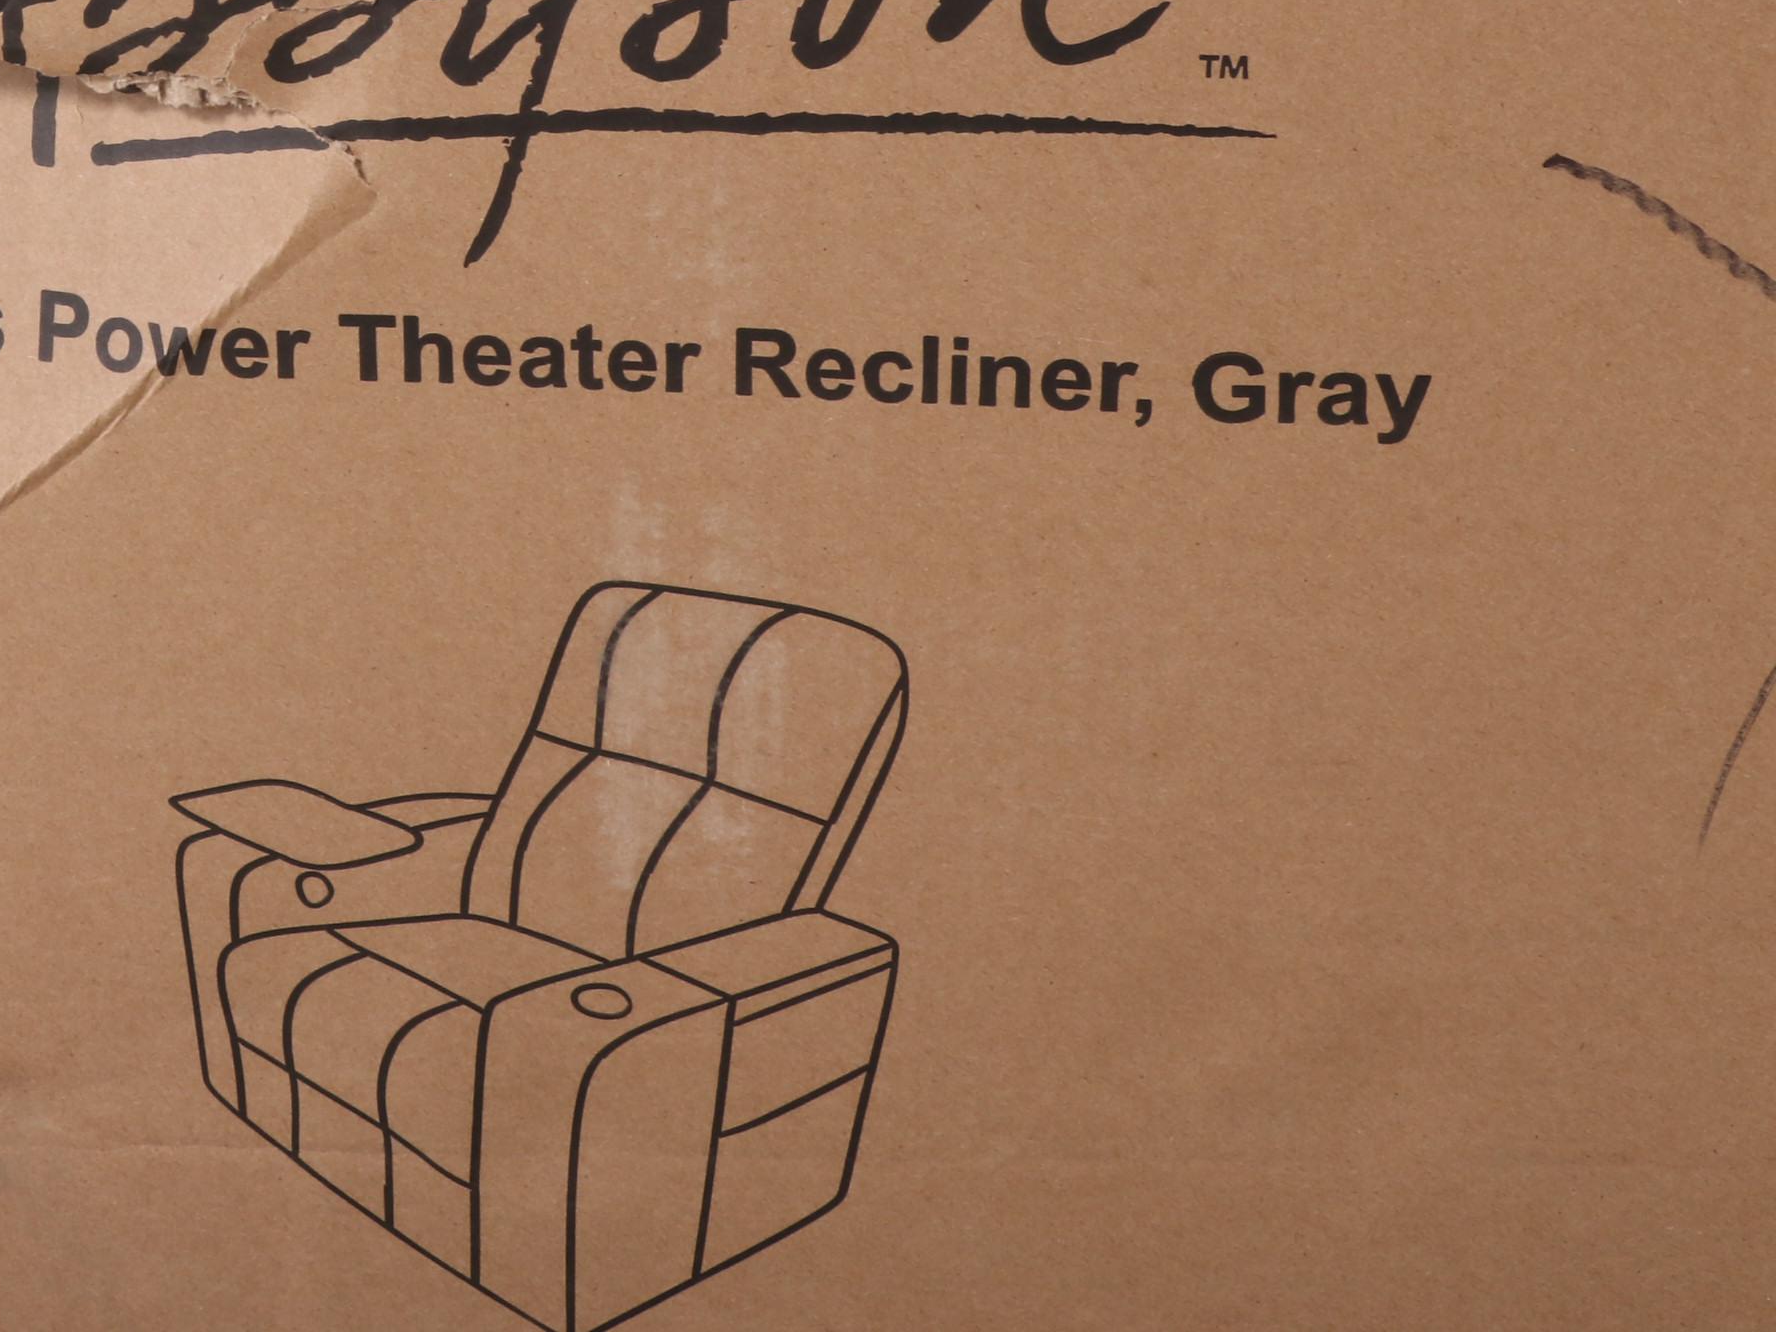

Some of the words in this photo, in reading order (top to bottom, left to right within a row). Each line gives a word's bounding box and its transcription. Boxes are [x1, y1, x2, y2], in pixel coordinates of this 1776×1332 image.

[35, 289, 311, 380] Power
[339, 313, 702, 393] Theater
[735, 327, 1153, 428] Recliner,
[1191, 351, 1433, 445] Gray
